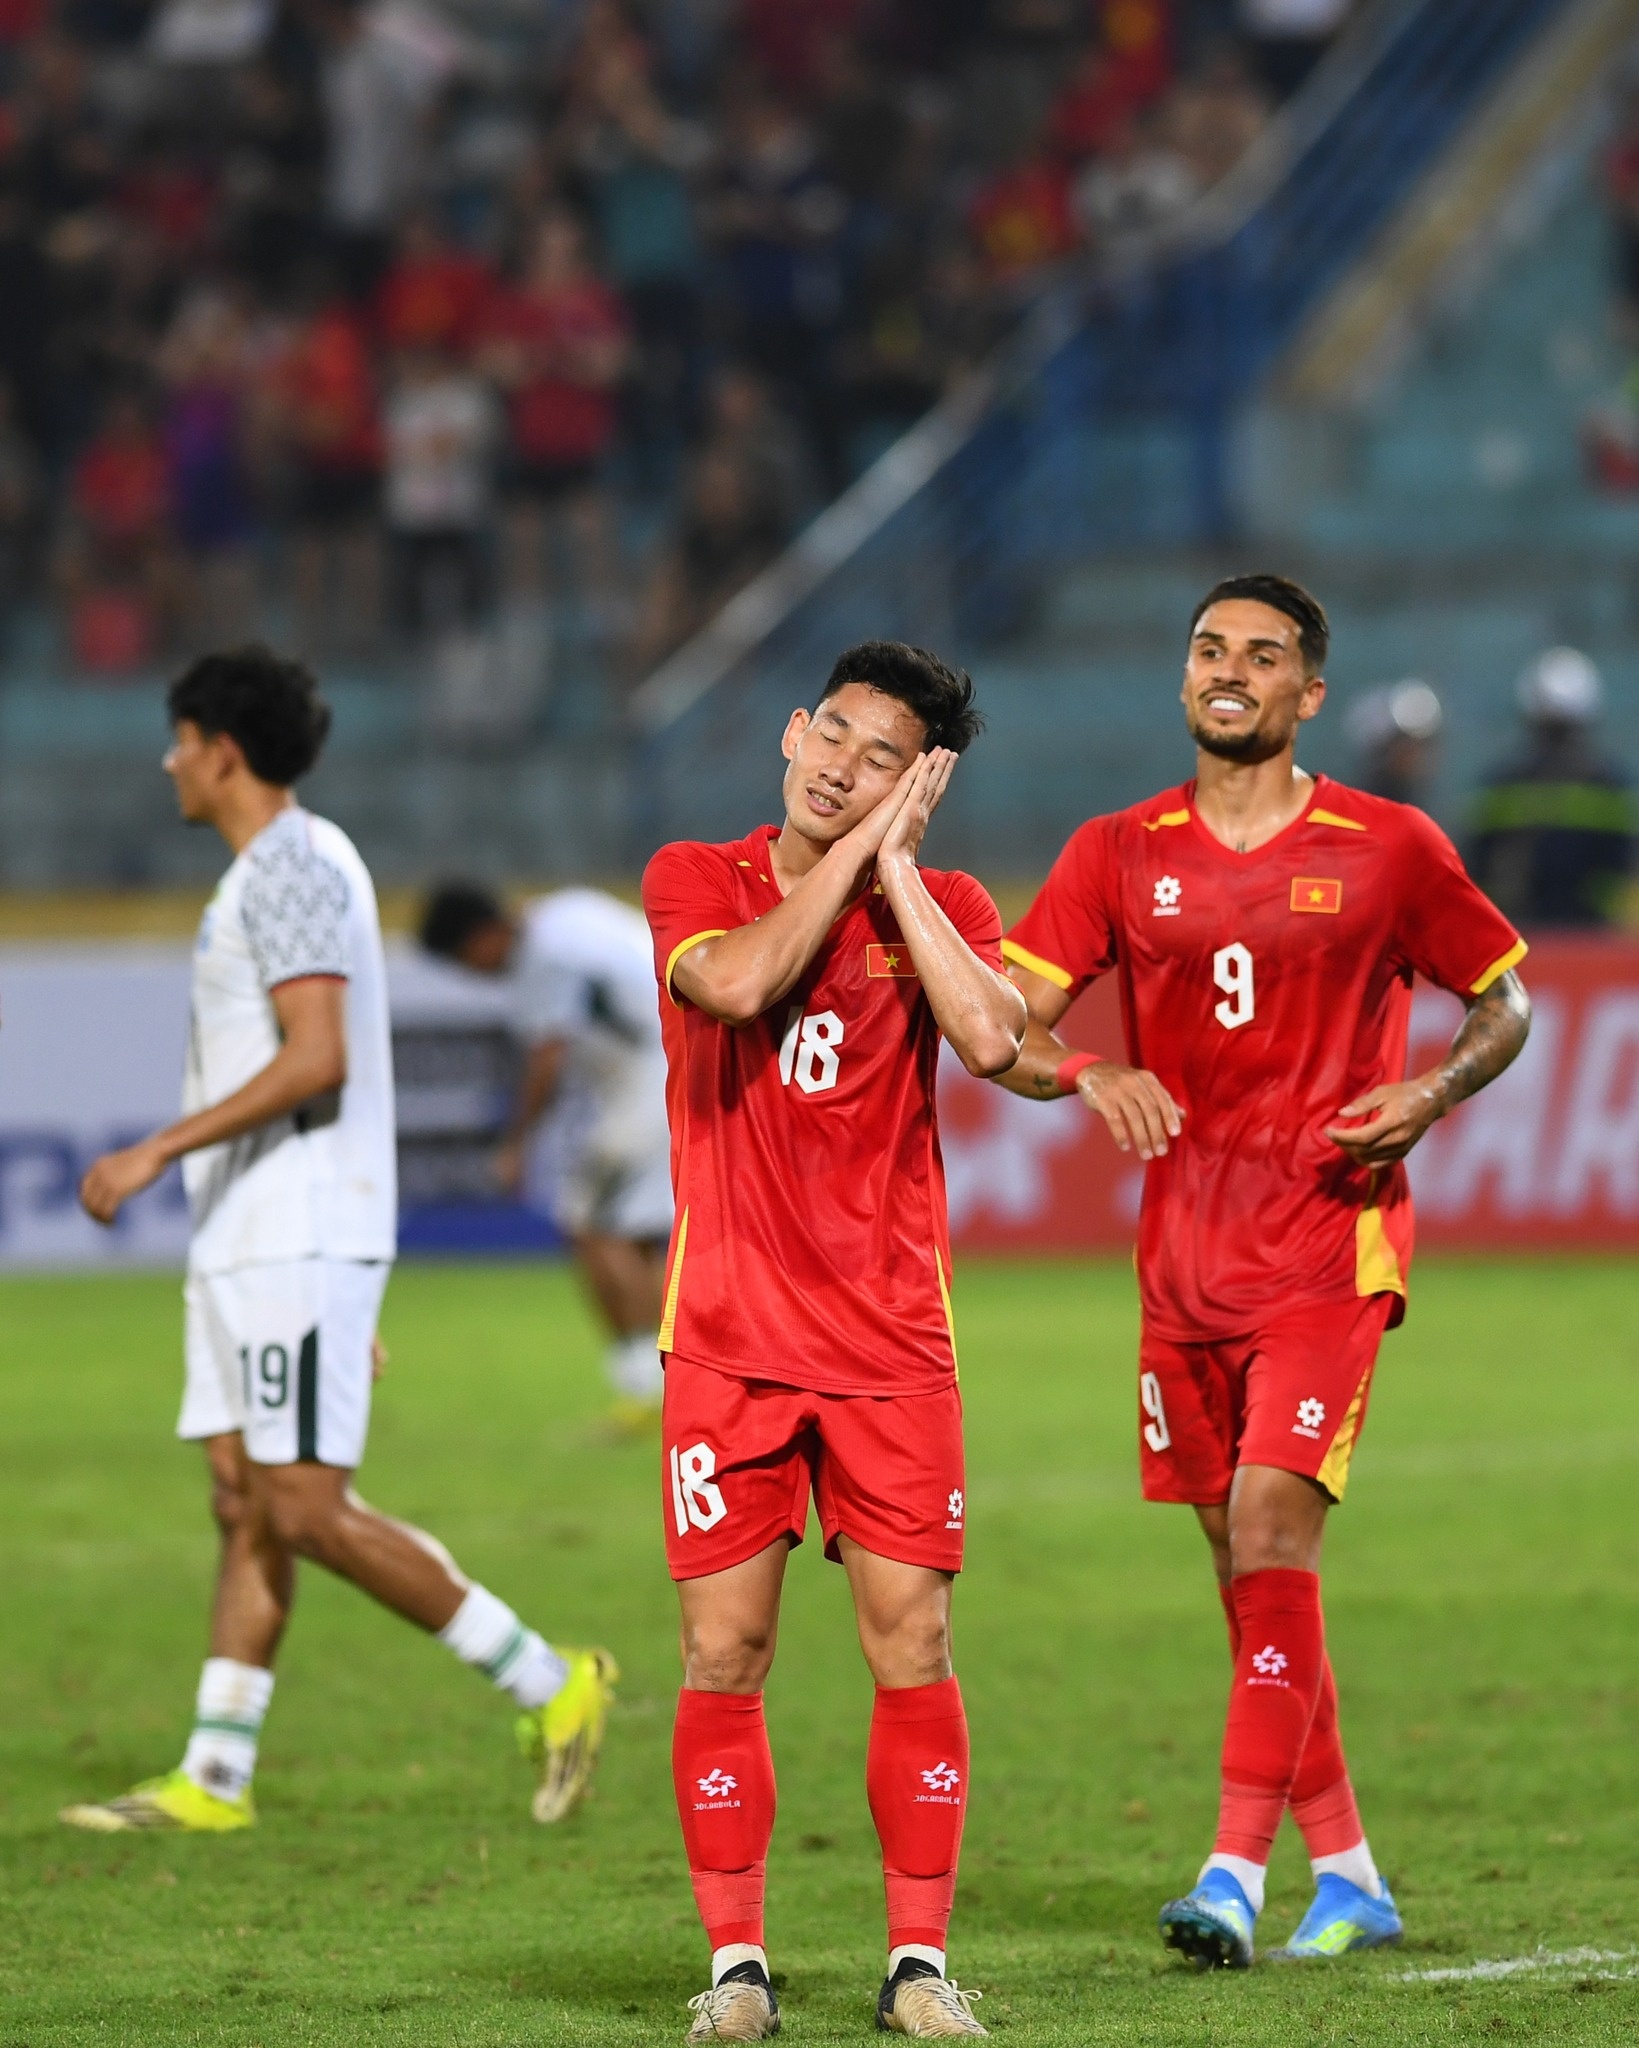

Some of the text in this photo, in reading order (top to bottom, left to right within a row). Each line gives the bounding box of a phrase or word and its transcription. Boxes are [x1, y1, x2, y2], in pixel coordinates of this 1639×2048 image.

[1213, 941, 1255, 1030] 9
[778, 1005, 845, 1094] 18
[238, 1342, 288, 1410] 19
[1140, 1371, 1172, 1453] 9
[669, 1441, 728, 1537] 18
